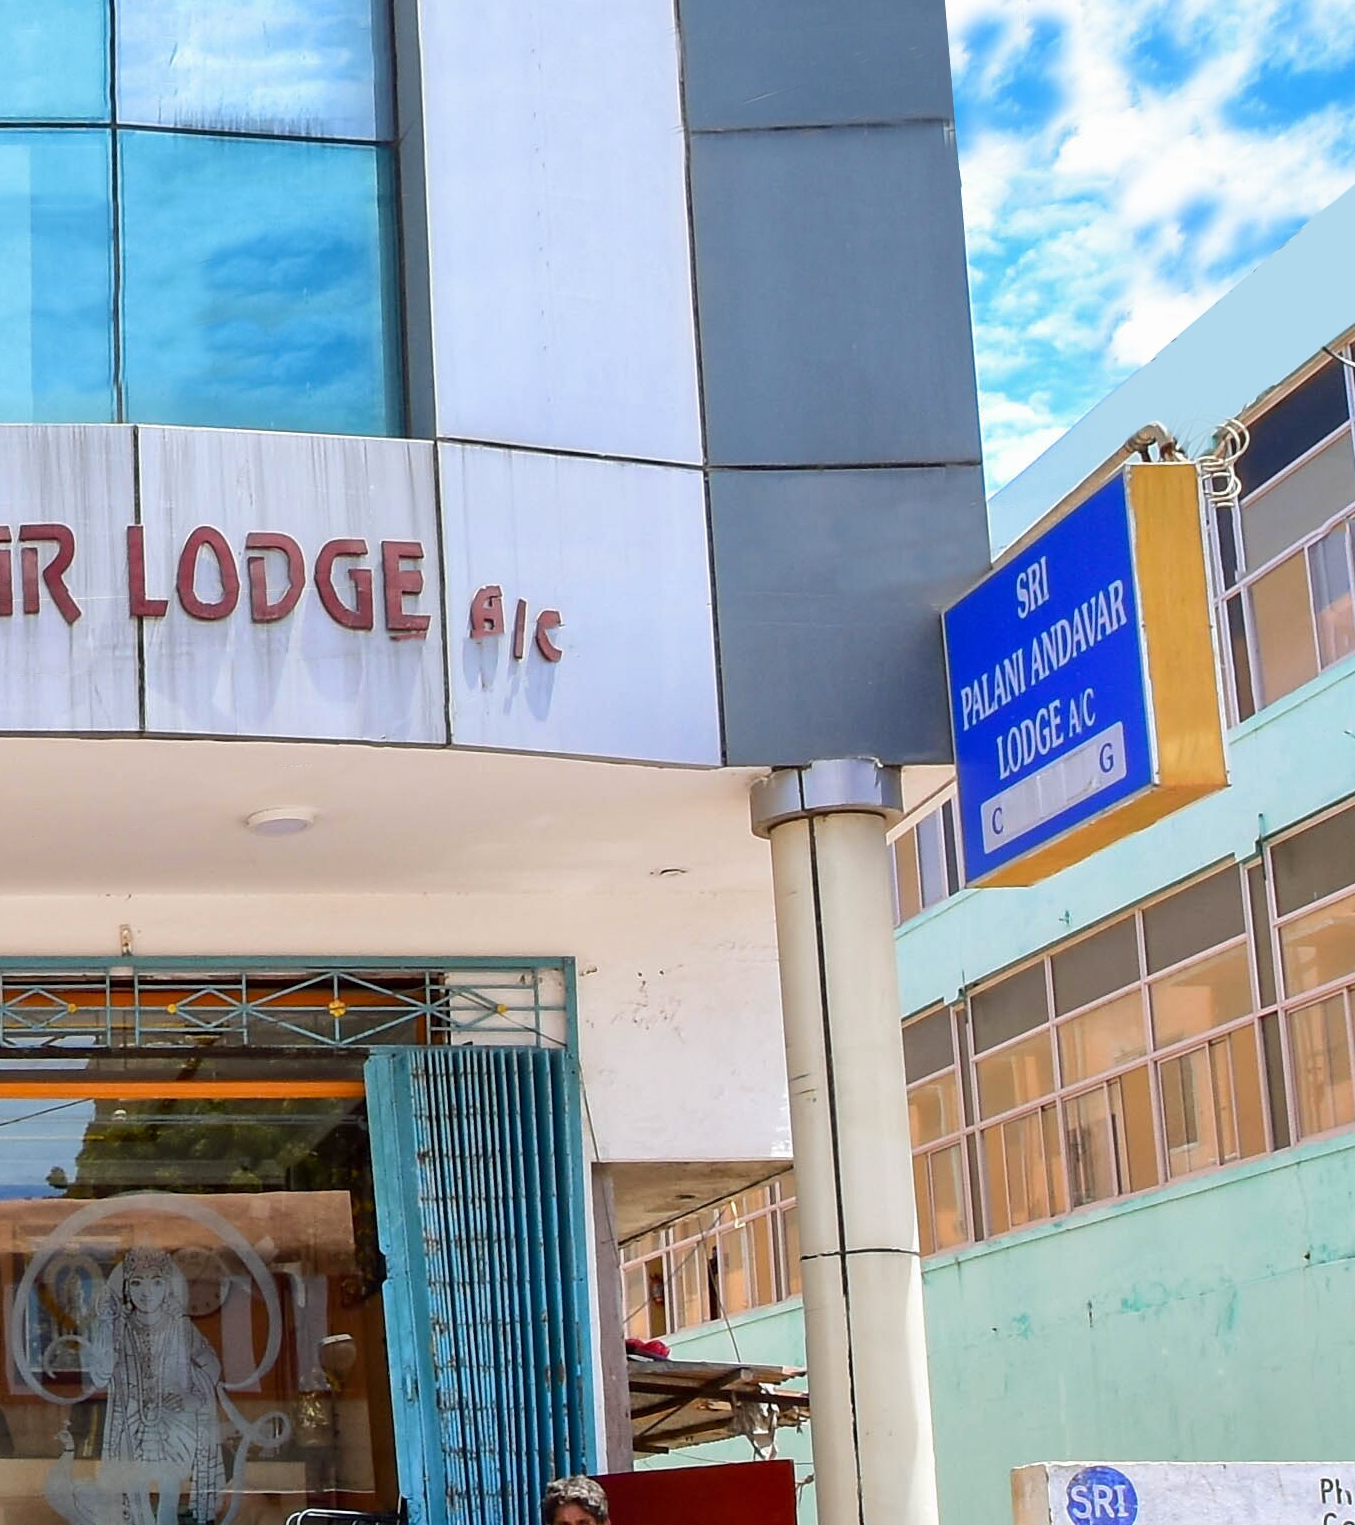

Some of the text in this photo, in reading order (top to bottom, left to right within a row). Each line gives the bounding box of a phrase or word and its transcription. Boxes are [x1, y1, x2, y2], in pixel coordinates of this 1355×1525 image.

[127, 525, 431, 641] LODGE
[1016, 556, 1050, 619] SRI
[961, 579, 1127, 731] PALANI ANDAVAR
[996, 688, 1096, 780] LODGE A/C
[1070, 1484, 1128, 1519] SRI
